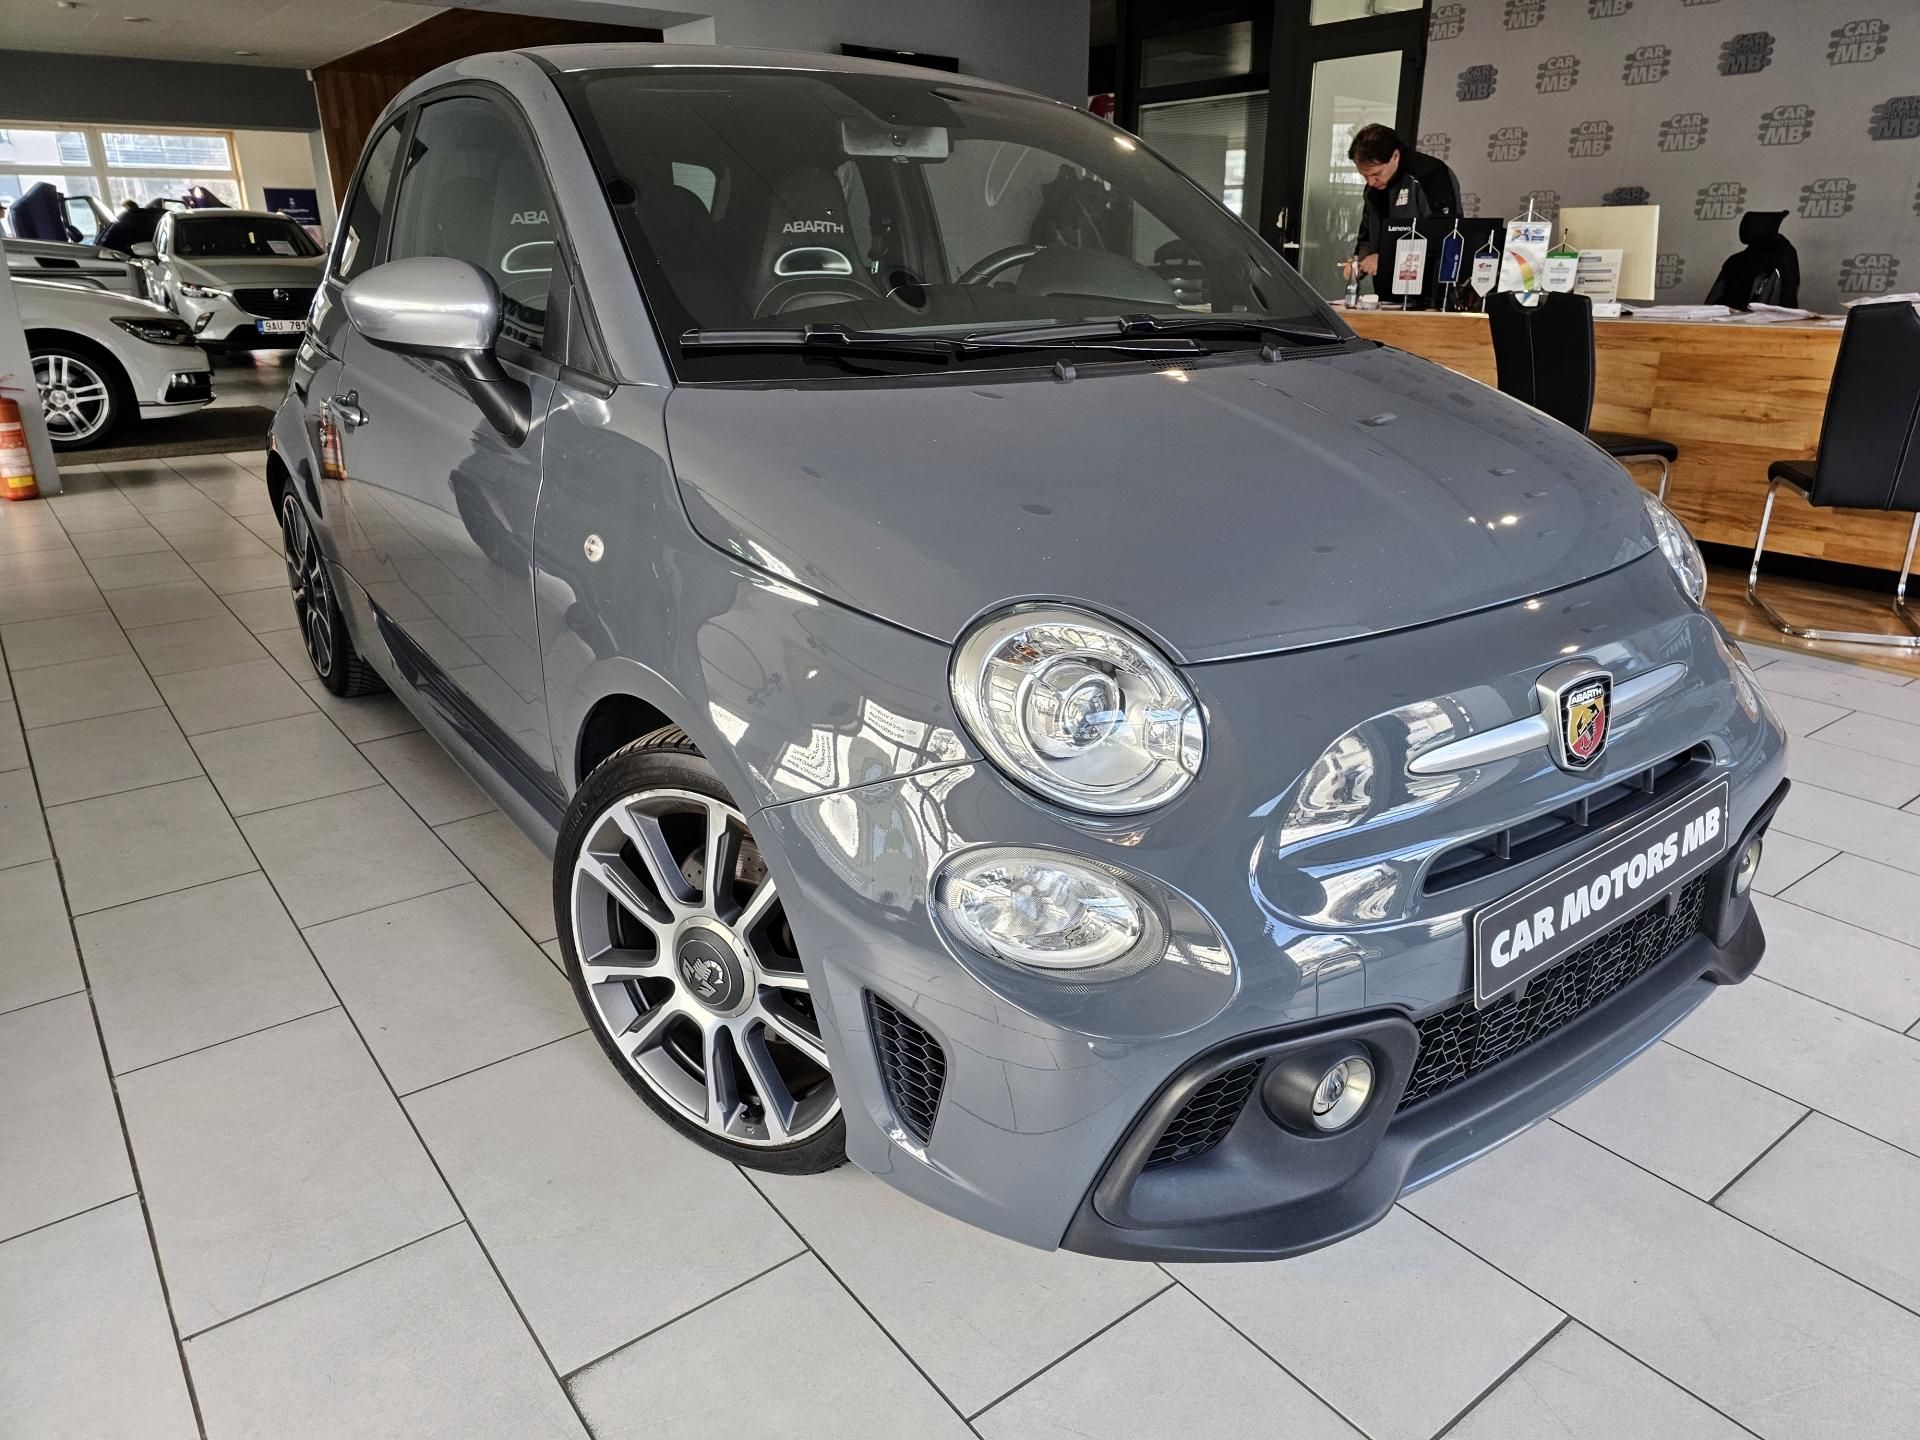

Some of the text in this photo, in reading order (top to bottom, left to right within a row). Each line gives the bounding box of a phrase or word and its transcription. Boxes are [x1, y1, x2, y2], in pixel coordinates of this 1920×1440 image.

[1437, 4, 1460, 18] CAR
[1592, 1, 1627, 18] MB
[1508, 11, 1538, 29] MB
[1844, 20, 1881, 36] CAR
[1430, 22, 1459, 40] MB
[1635, 46, 1665, 60] CAR
[1833, 42, 1878, 63] MB
[1546, 56, 1574, 70] CAR
[1725, 53, 1763, 73] MB
[1628, 65, 1662, 84] MB
[1461, 81, 1490, 99] MB
[1540, 75, 1573, 93] MB
[1671, 113, 1702, 128] CAR
[1772, 105, 1808, 120] CAR
[1497, 128, 1522, 140] CAR
[1580, 121, 1608, 135] CAR
[1763, 126, 1804, 145] MB
[1422, 134, 1446, 146] CAR
[1573, 139, 1604, 156] MB
[1663, 133, 1699, 151] MB
[1491, 145, 1520, 161] MB
[1708, 183, 1740, 196] CAR
[1813, 178, 1849, 193] CAR
[1699, 202, 1737, 219] MB
[1802, 200, 1845, 218] MB
[510, 210, 550, 225] ABA
[782, 220, 844, 234] ABARTH
[1657, 254, 1678, 267] AR
[1854, 254, 1891, 268] CAR
[1844, 274, 1888, 292] MB
[265, 320, 306, 331] 9AU 781
[1571, 688, 1602, 704] ABARTH
[1490, 806, 1721, 968] CAR MOTORS MB
